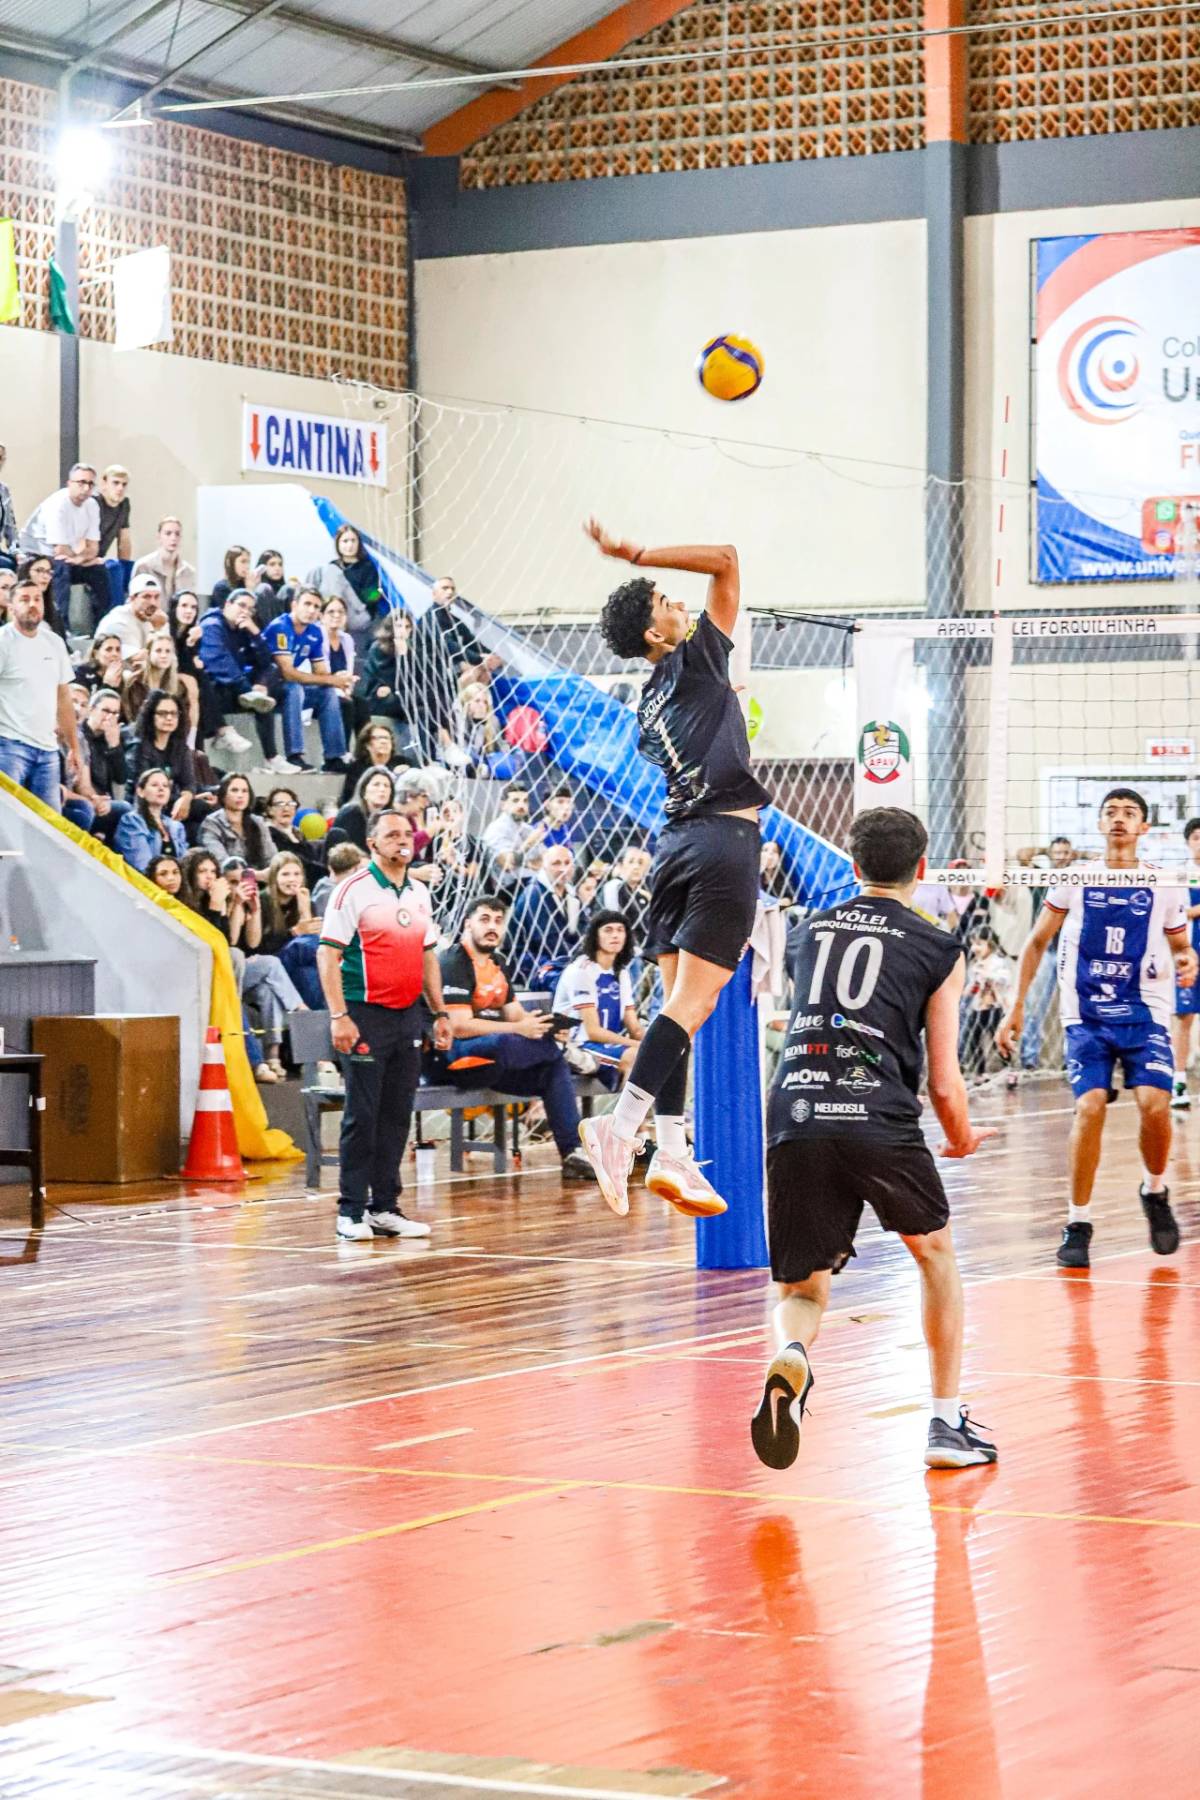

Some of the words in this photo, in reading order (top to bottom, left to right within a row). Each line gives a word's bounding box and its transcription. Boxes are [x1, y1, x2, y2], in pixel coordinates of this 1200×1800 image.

[1163, 366, 1200, 402] U
[265, 415, 366, 477] CANTINA
[1180, 443, 1200, 469] F
[1081, 556, 1200, 576] www.unive
[1040, 618, 1157, 635] FORQUILHINHA
[1040, 872, 1158, 886] FORQUILHINHA
[835, 909, 888, 925] VÔLEI
[808, 919, 907, 939] FORQUILHINHA-SC
[1104, 926, 1126, 955] 18
[807, 931, 884, 1010] 10
[814, 1102, 869, 1114] NEUROSUL
